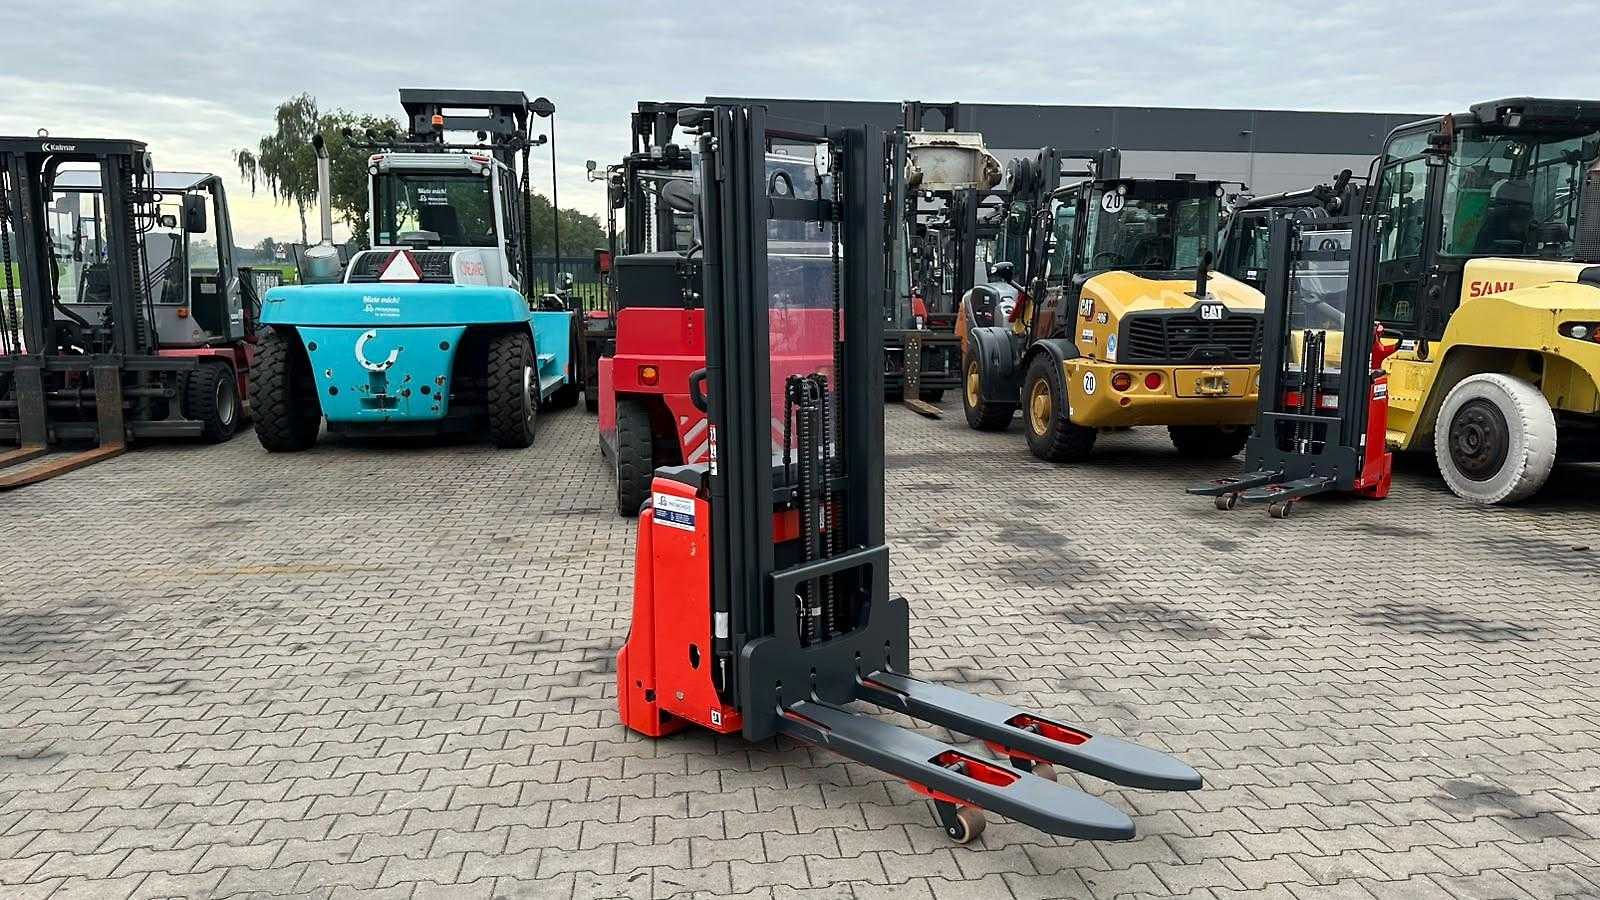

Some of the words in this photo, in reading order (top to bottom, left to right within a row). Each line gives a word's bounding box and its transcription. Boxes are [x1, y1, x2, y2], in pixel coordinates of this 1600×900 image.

[50, 143, 76, 151] Kalmar
[1106, 194, 1120, 208] 20
[1080, 299, 1094, 316] CAT
[1201, 304, 1224, 320] CAT
[1085, 376, 1094, 391] 20
